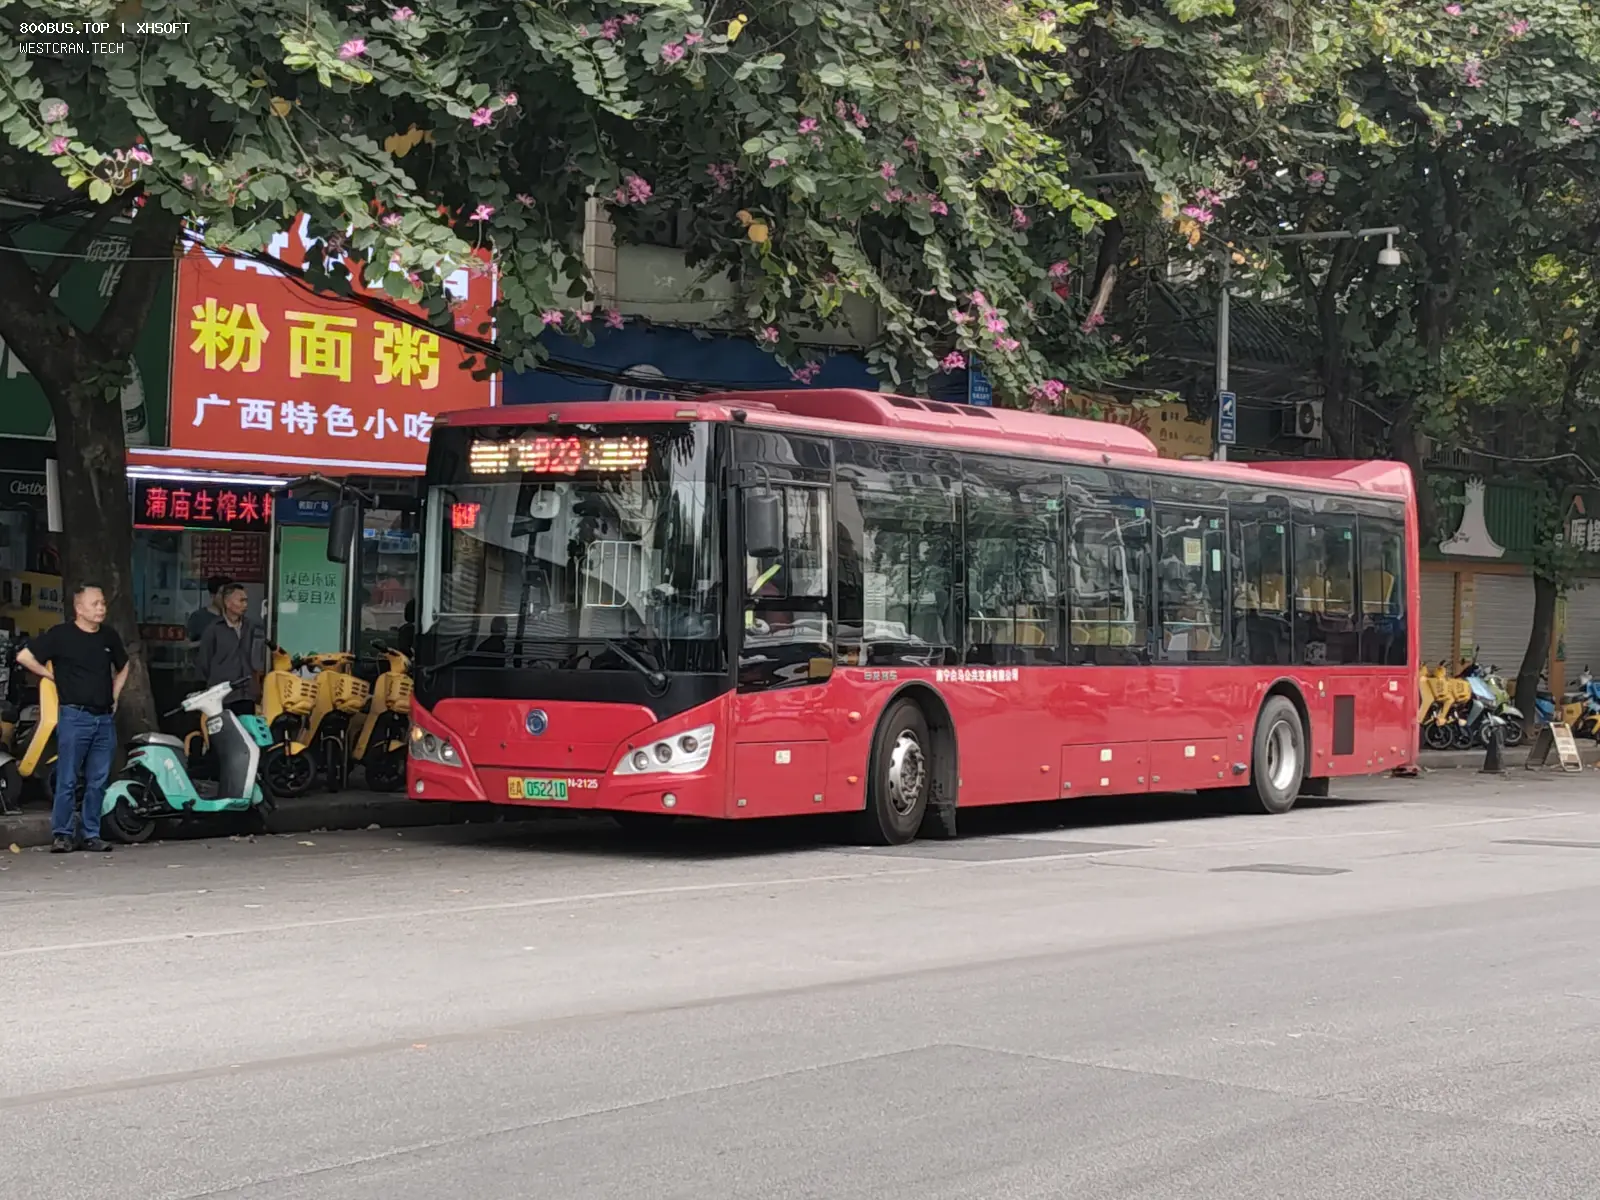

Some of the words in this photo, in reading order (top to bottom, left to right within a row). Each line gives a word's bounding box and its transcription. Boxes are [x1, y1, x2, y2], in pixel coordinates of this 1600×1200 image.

[189, 296, 440, 390] 粉面粥
[192, 393, 435, 443] 广西特色小吃
